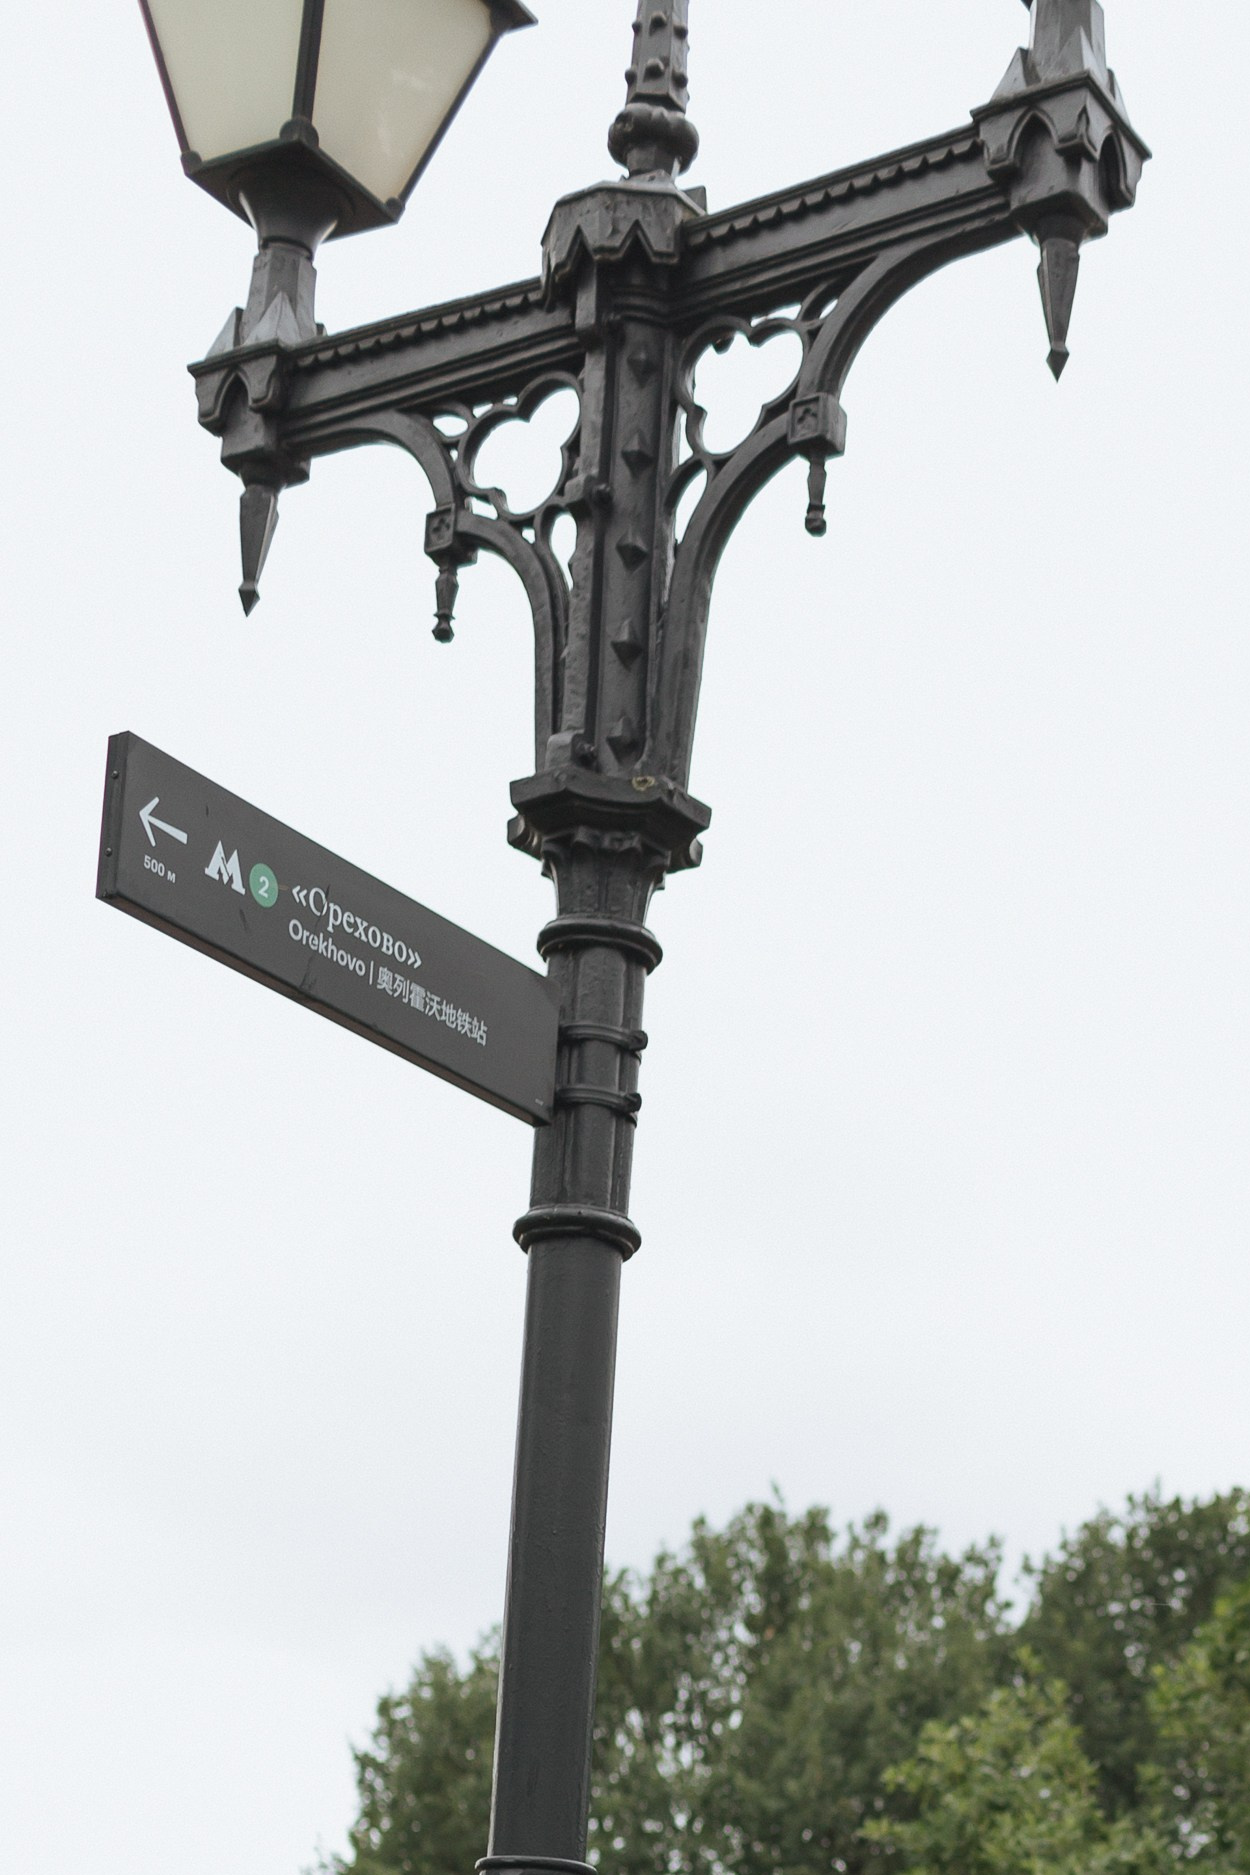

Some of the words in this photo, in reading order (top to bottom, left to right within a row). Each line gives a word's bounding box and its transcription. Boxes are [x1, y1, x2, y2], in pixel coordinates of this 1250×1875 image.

[143, 854, 166, 878] 500
[258, 876, 270, 899] 2
[291, 885, 422, 969] «Орехово»
[288, 918, 366, 977] Orekhovo
[376, 966, 488, 1047] 奥列霍沃地铁站
